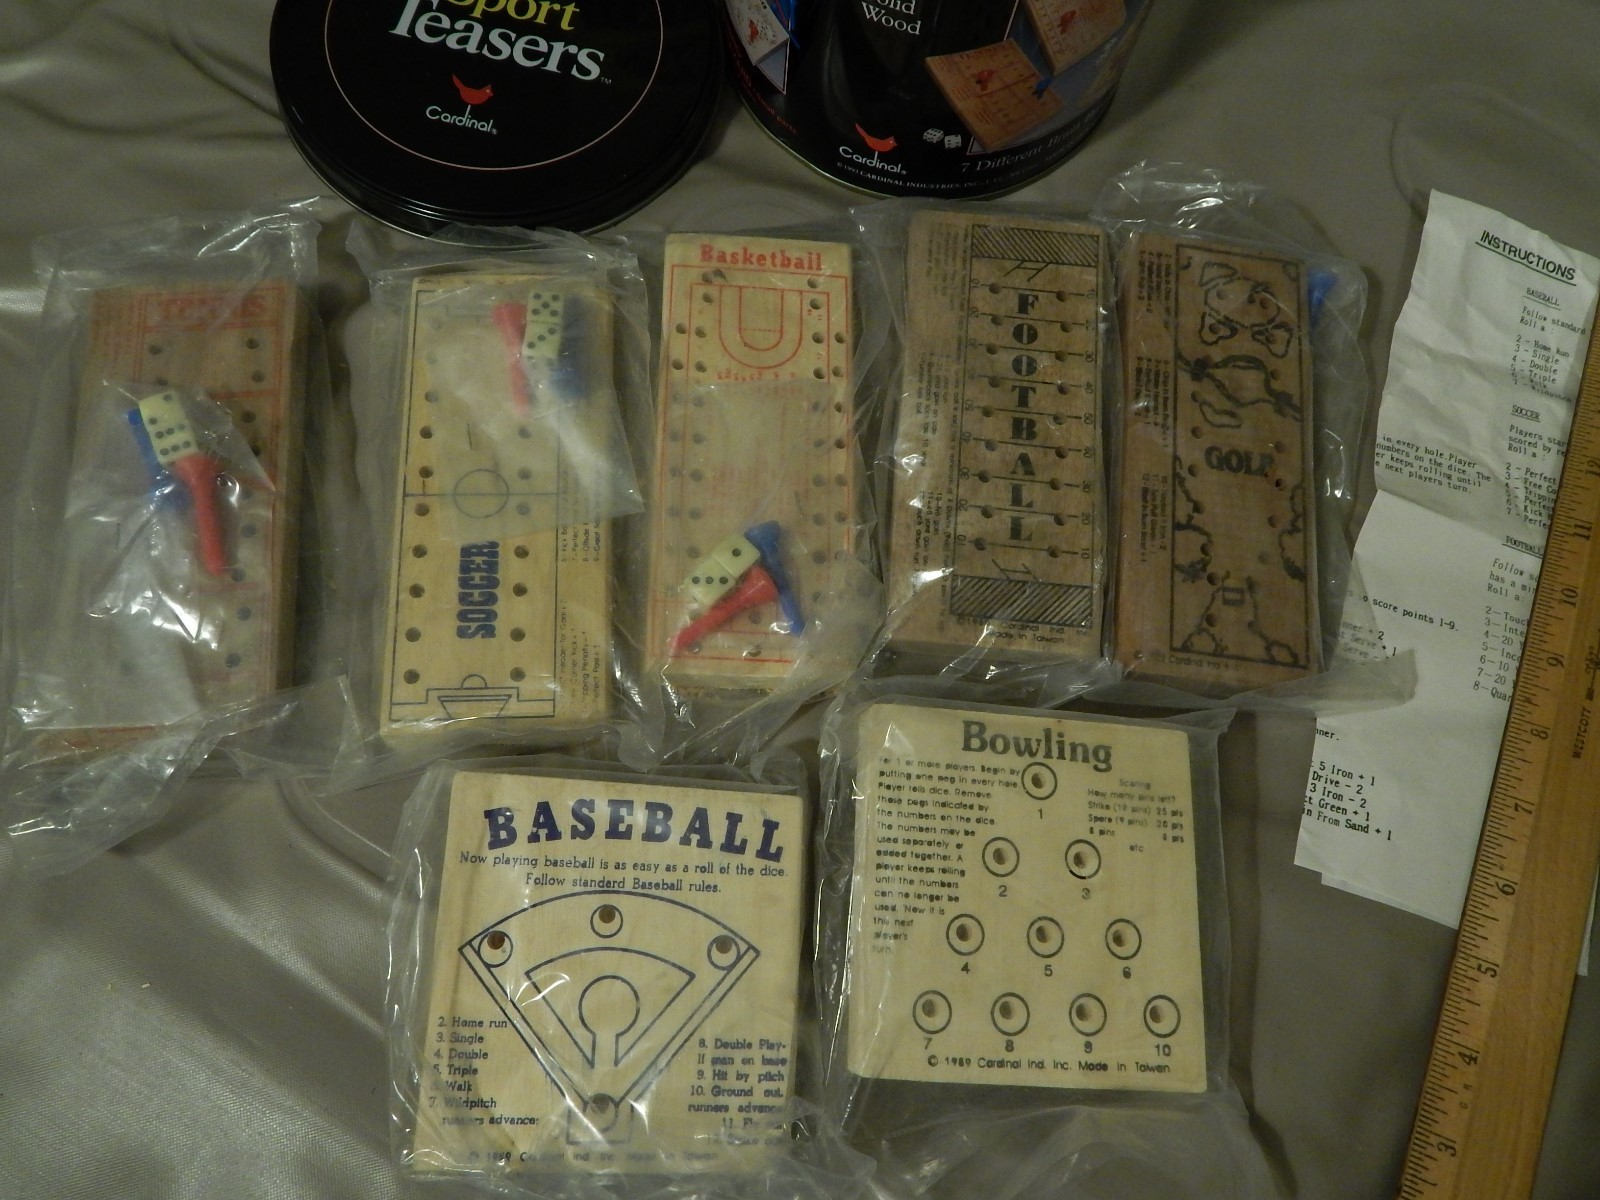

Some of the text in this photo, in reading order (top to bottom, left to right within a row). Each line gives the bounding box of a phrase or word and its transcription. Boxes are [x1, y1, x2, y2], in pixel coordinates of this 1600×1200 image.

[446, 0, 579, 30] port
[862, 1, 921, 35] Wood
[389, 0, 604, 82] Teasers
[426, 105, 494, 134] Cardinal
[839, 146, 902, 174] Cardinal
[976, 146, 1042, 171] Different
[700, 244, 822, 271] Basketball
[1480, 230, 1575, 280] INSTRUCTIONS
[1527, 287, 1559, 306] BASEBALL
[1522, 306, 1586, 335] Follow standard
[1532, 349, 1559, 365] Single
[1530, 360, 1558, 374] Double
[1512, 405, 1539, 420] SOCCER
[1509, 425, 1543, 440] Players
[1397, 439, 1420, 452] every
[1509, 436, 1537, 448] scored
[1377, 443, 1409, 457] numbers
[1429, 459, 1443, 468] the
[1477, 472, 1491, 481] The
[1385, 463, 1403, 474] next
[1409, 471, 1443, 486] players
[1391, 454, 1481, 487] keeps rolling until
[1493, 558, 1524, 576] Follow
[1489, 571, 1505, 584] has
[457, 541, 499, 640] SOCCER
[1487, 583, 1508, 596] Roll
[1559, 588, 1578, 608] 10
[1373, 598, 1398, 613] score
[1403, 609, 1434, 624] points
[1531, 728, 1549, 740] 8
[962, 720, 1112, 772] Bowling
[1320, 761, 1325, 770] 5
[1332, 765, 1353, 779] Iron
[971, 778, 994, 787] every
[1312, 771, 1363, 794] Drive 2
[1310, 783, 1343, 801] 3 Iron
[1038, 808, 1043, 819] 1
[1319, 798, 1347, 815] Green
[1514, 802, 1532, 816] 7
[897, 811, 936, 820] numbers
[1317, 811, 1369, 833] From Sand
[483, 798, 783, 863] BASEBALL
[898, 824, 936, 833] numbers
[460, 851, 788, 876] Now playing baseball is as easy as a roll of the dice.
[526, 873, 721, 892] Follow standard Baseball rules.
[920, 880, 959, 888] numbers
[998, 885, 1008, 898] 2
[1082, 888, 1091, 900] 3
[961, 962, 970, 975] 4
[1044, 965, 1053, 978] 5
[1122, 967, 1132, 979] 6
[1477, 965, 1498, 978] 5
[452, 1017, 483, 1028] Home
[489, 1019, 507, 1028] run
[449, 1032, 484, 1045] Single
[715, 1038, 752, 1049] Double
[924, 1038, 932, 1049] 7
[1005, 1039, 1014, 1052] 8
[449, 1049, 488, 1059] Double
[1084, 1041, 1092, 1053] 9
[1155, 1044, 1171, 1056] 10
[945, 1057, 971, 1067] 1989
[978, 1058, 1021, 1069] Cardinal
[1079, 1060, 1108, 1071] Made
[1135, 1062, 1170, 1073] Taiwan
[1458, 1049, 1478, 1066] 4
[447, 1064, 478, 1077] Triple
[736, 1070, 749, 1082] by
[758, 1070, 784, 1083] pitch
[446, 1080, 472, 1092] Walk
[711, 1085, 753, 1097] Ground
[1438, 1142, 1457, 1157] 3
